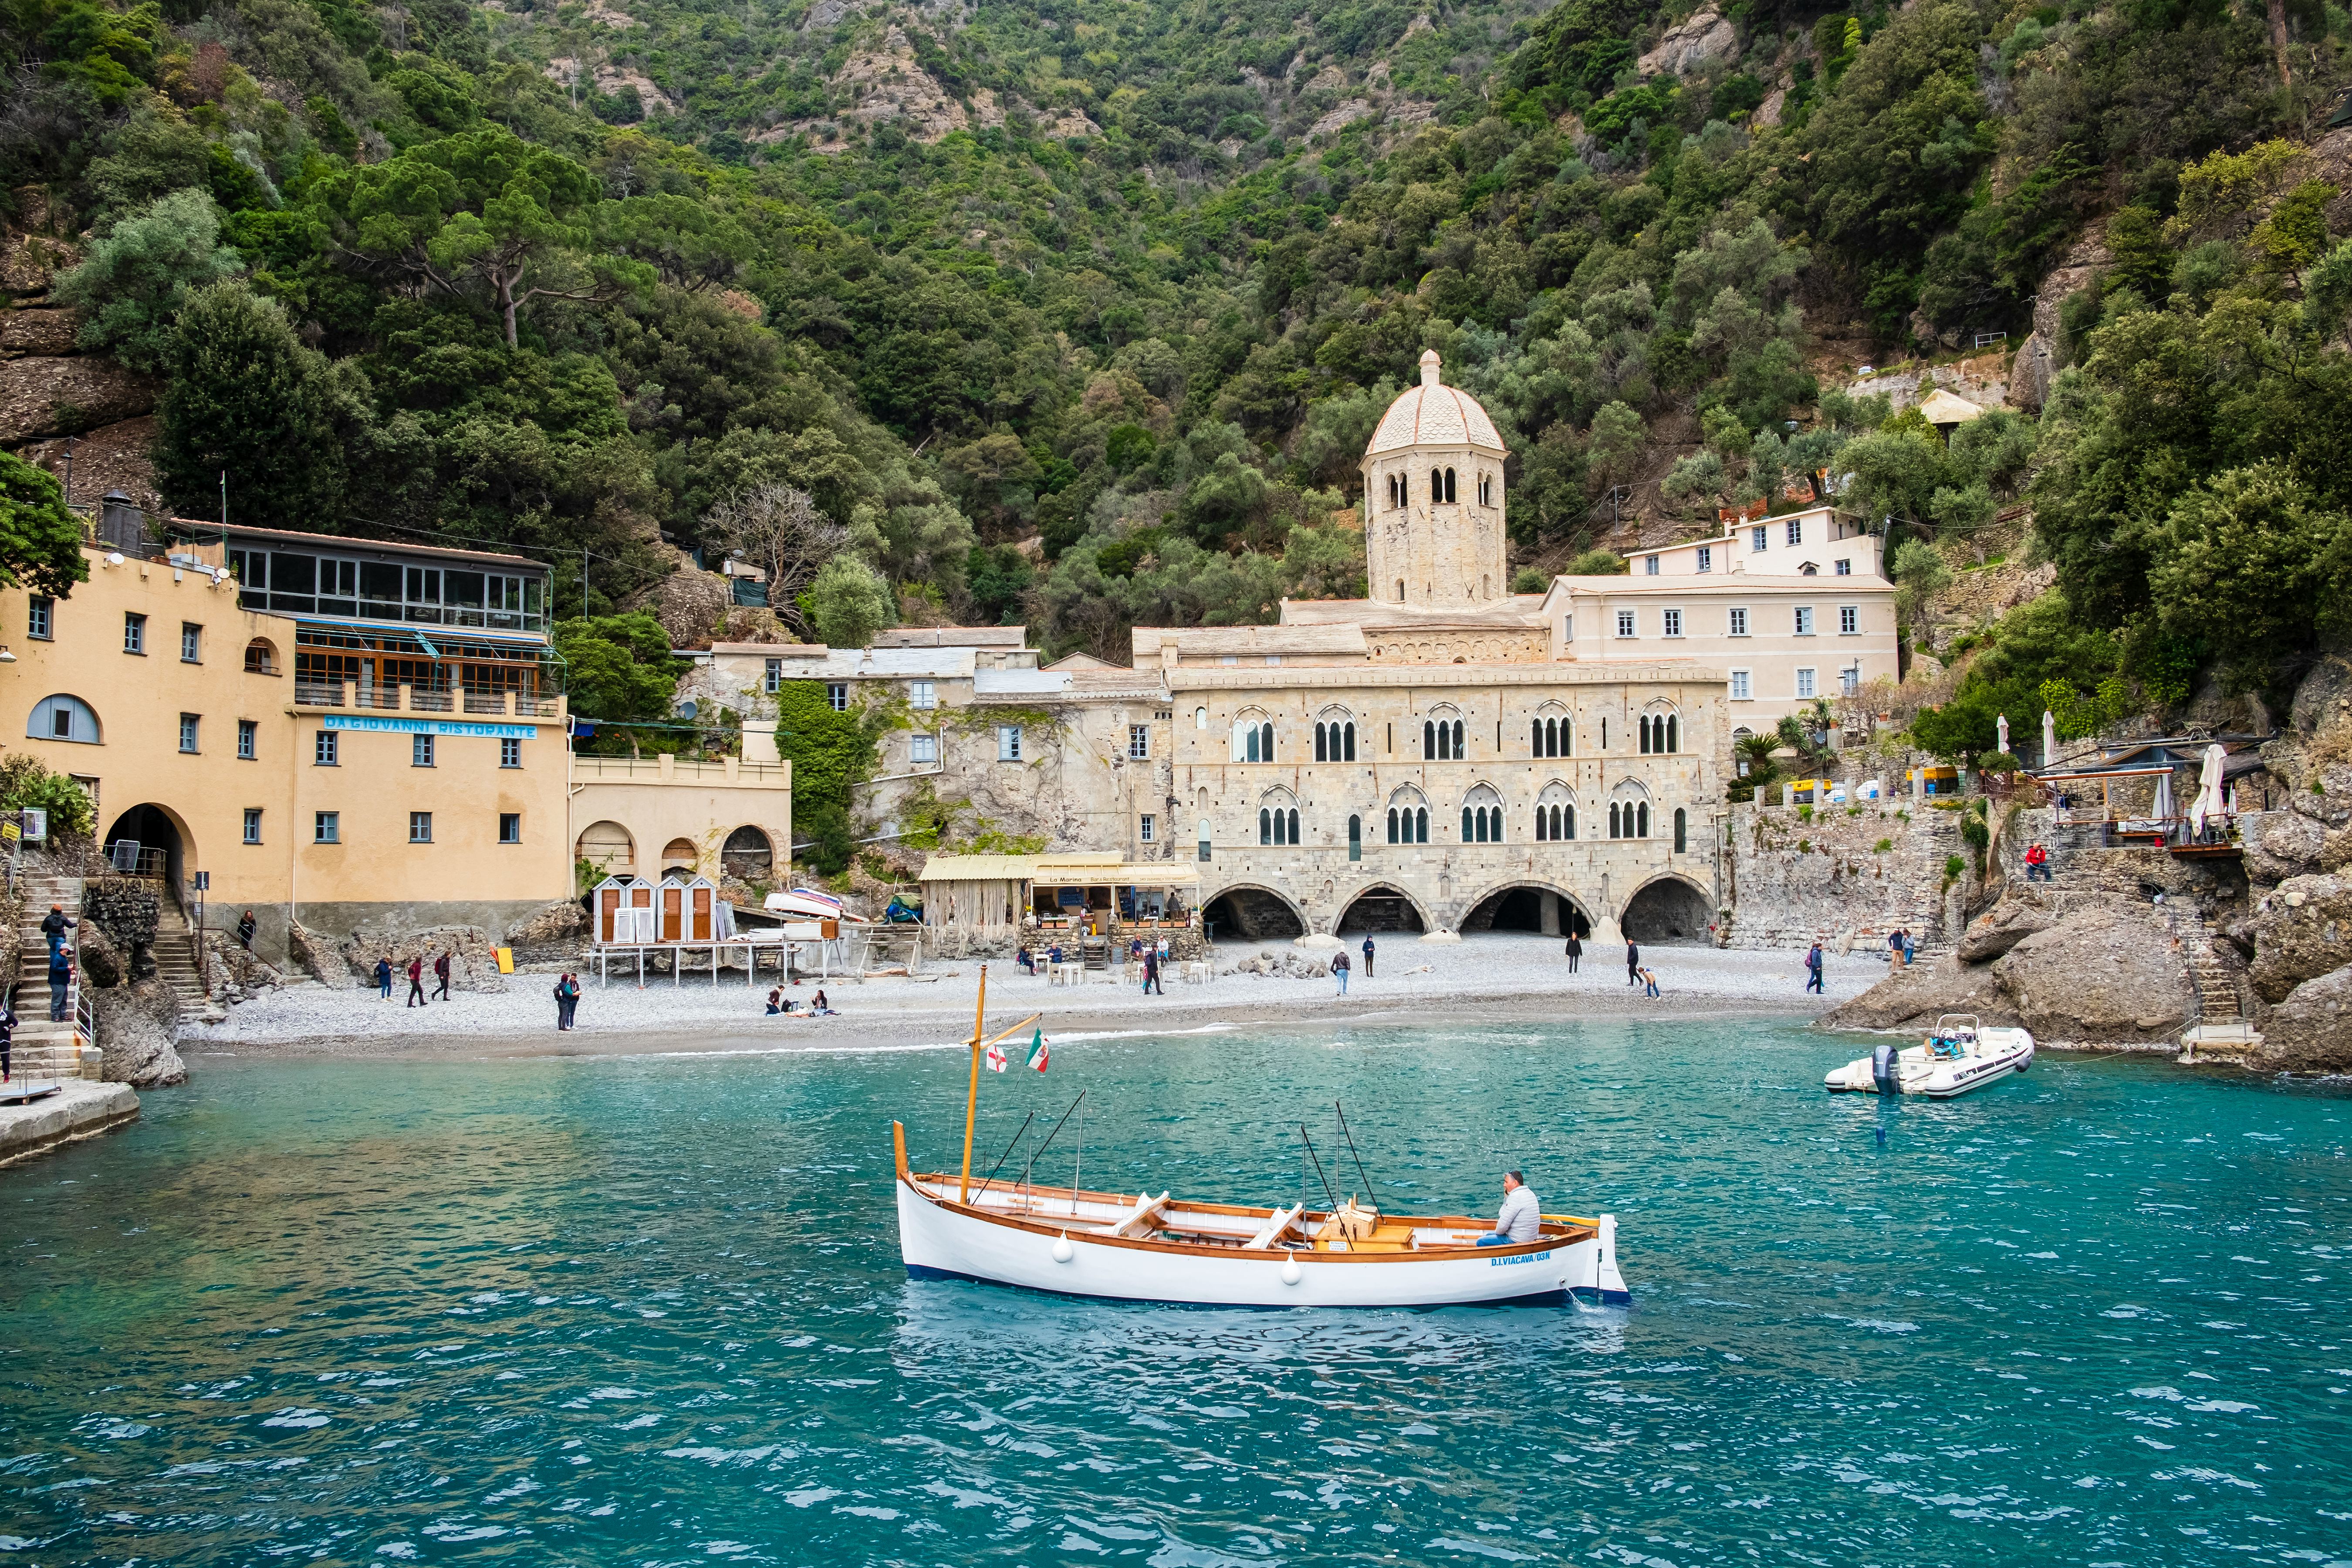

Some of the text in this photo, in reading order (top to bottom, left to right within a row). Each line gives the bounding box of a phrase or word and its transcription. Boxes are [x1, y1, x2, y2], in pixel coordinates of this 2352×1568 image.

[326, 716, 535, 737] DA GIOVANNI RISTORANTE
